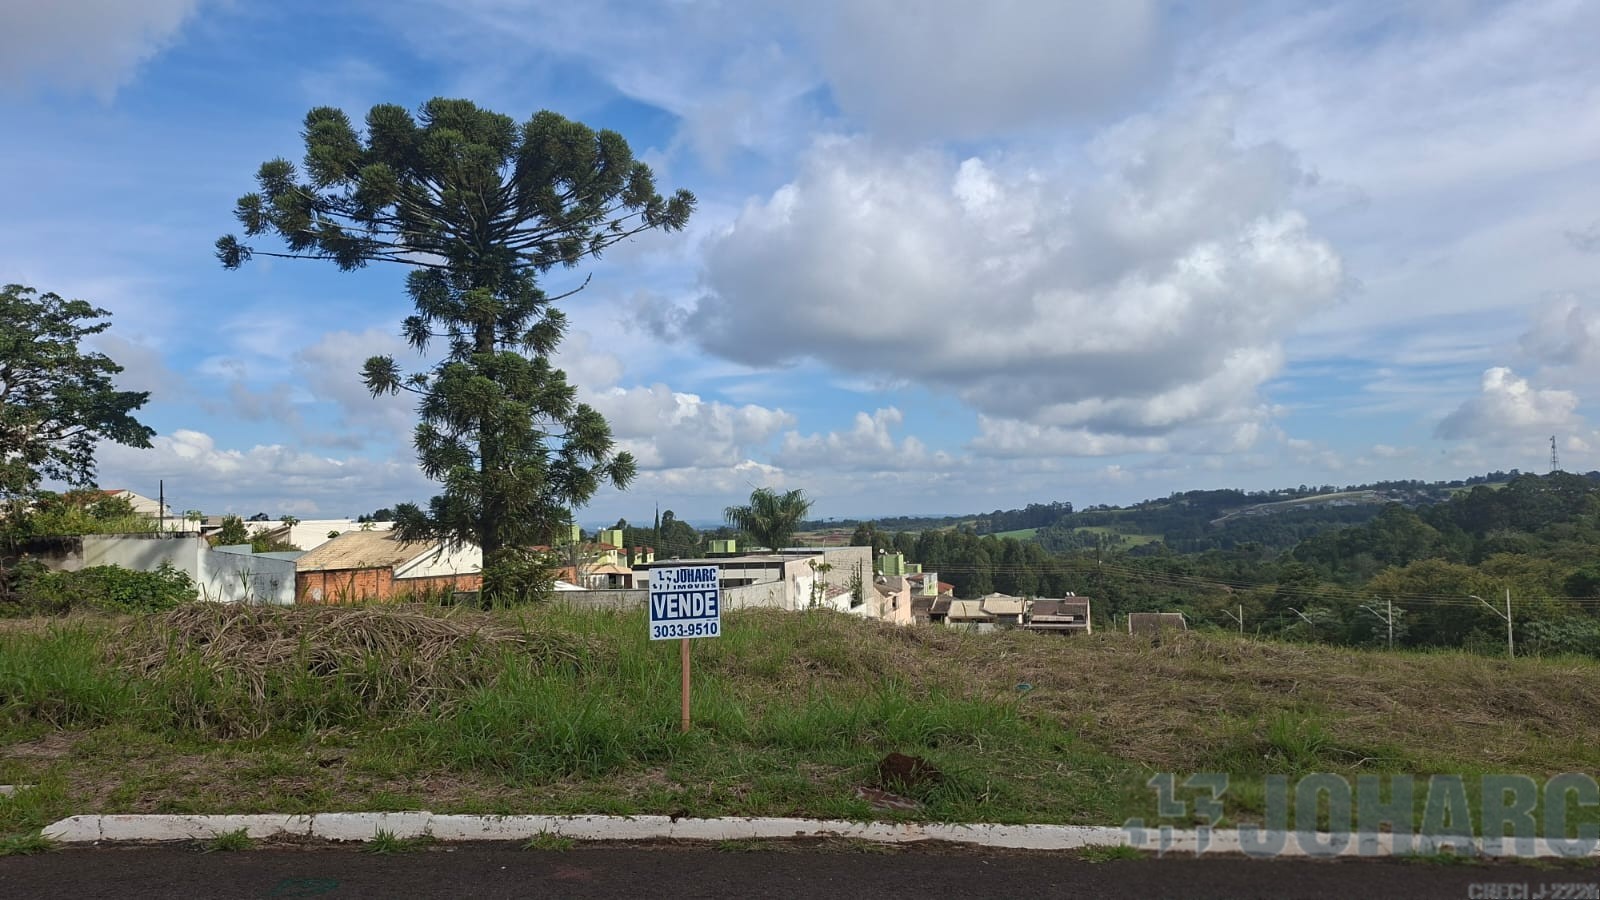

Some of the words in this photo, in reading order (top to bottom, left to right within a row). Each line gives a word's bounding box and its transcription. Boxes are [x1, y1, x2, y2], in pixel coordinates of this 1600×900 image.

[673, 568, 716, 583] JOHARC
[652, 591, 716, 619] VENDE
[654, 622, 718, 638] 3033-9510
